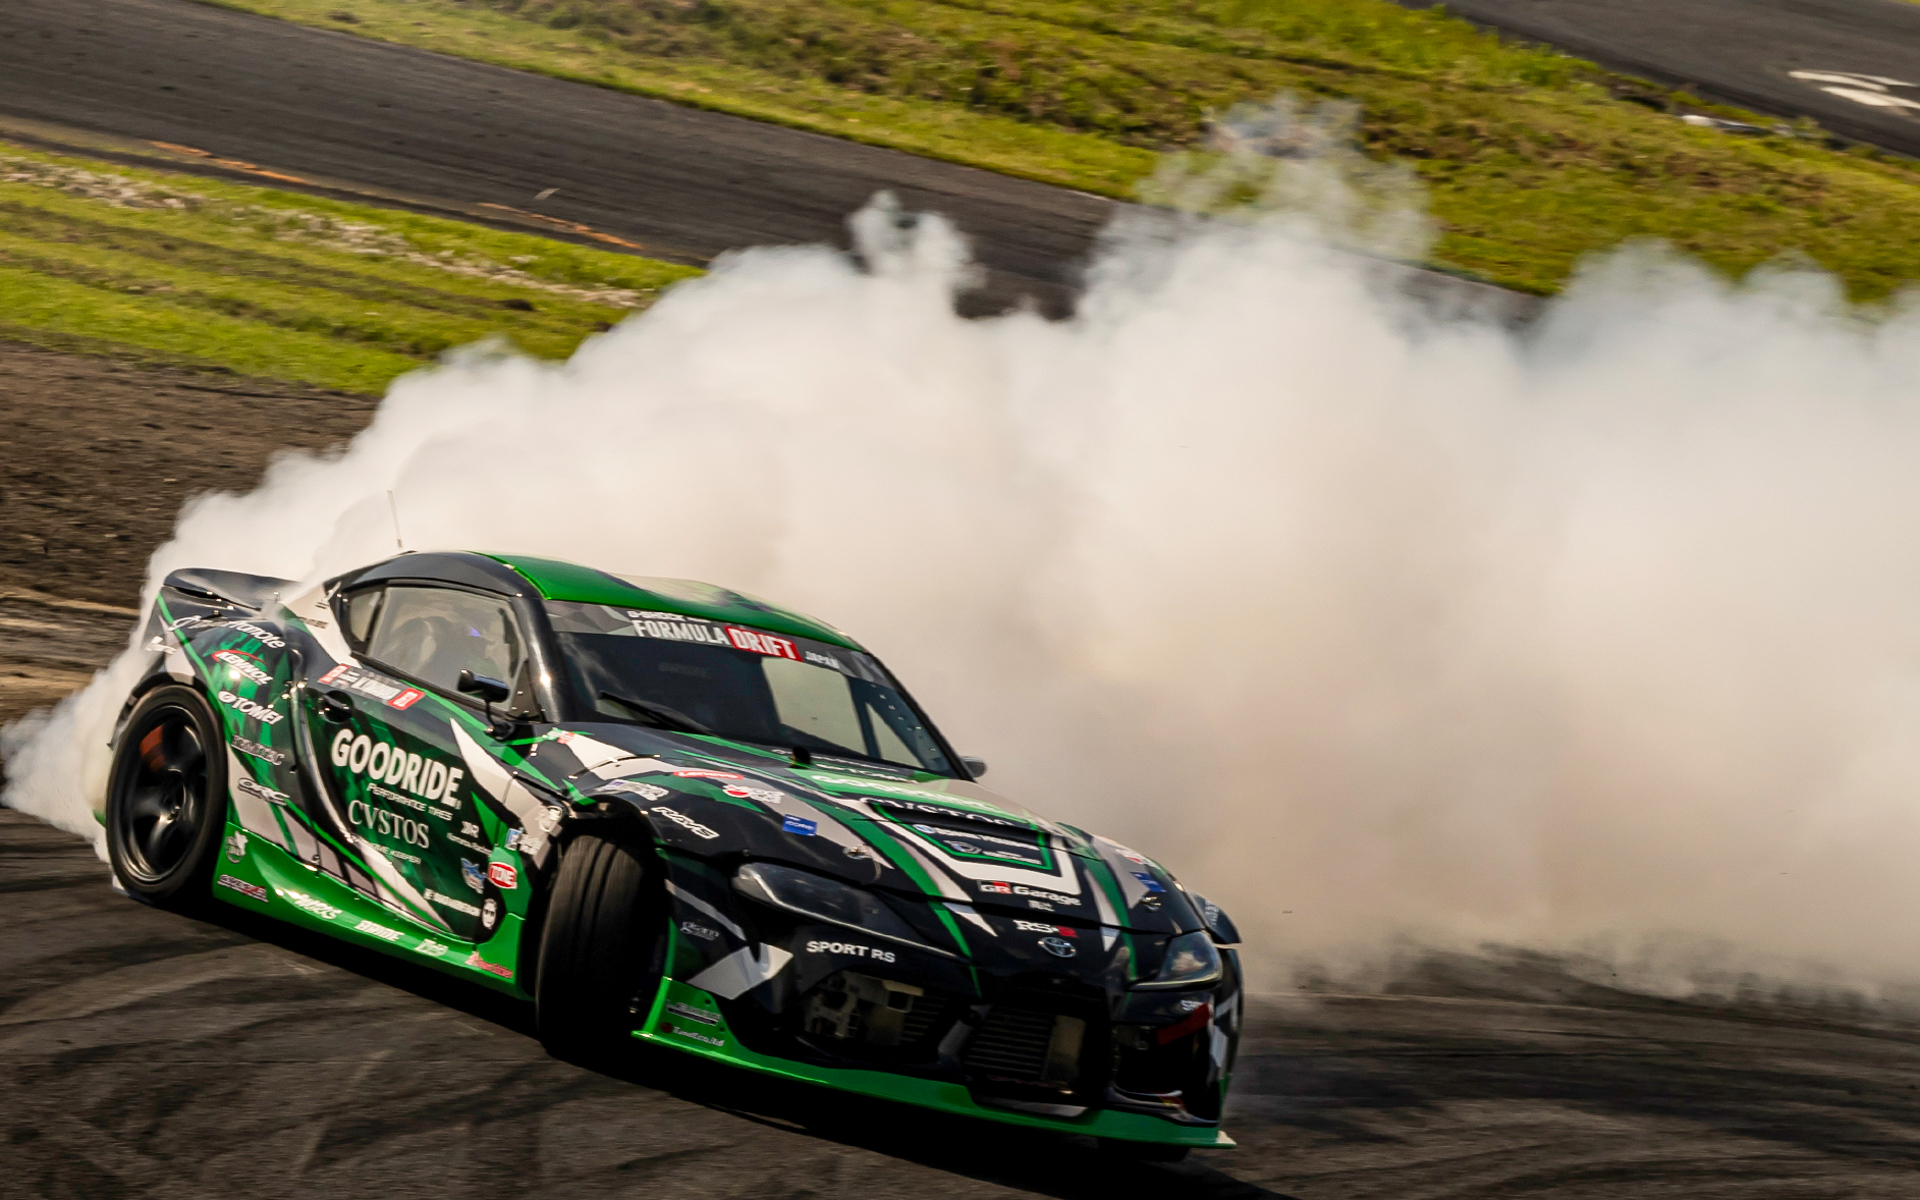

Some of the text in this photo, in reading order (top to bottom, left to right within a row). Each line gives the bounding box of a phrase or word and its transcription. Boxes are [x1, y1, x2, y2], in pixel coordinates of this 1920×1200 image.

[631, 620, 731, 646] FORMULA
[728, 628, 797, 660] DRIFT
[230, 696, 285, 725] TOMEI
[331, 728, 464, 808] GOODRIDE
[348, 799, 430, 849] CVSTOS
[1012, 886, 1082, 906] Garage
[806, 940, 895, 963] SPORT RS
